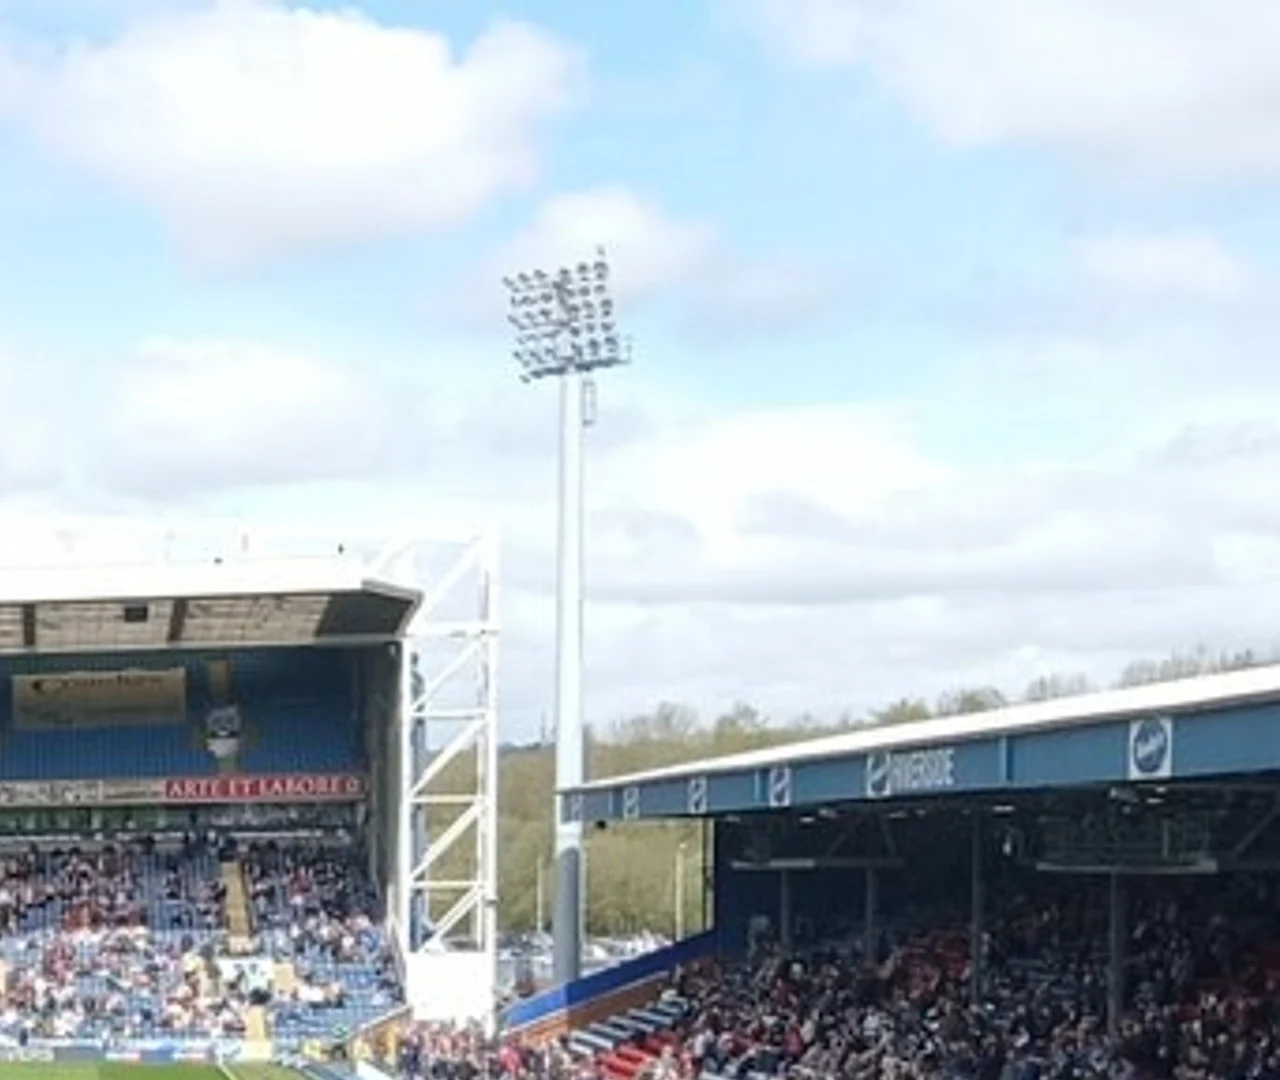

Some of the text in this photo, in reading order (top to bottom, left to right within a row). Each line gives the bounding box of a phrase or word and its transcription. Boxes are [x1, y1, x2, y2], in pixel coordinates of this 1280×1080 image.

[169, 775, 338, 798] ARTE ET LABORE
